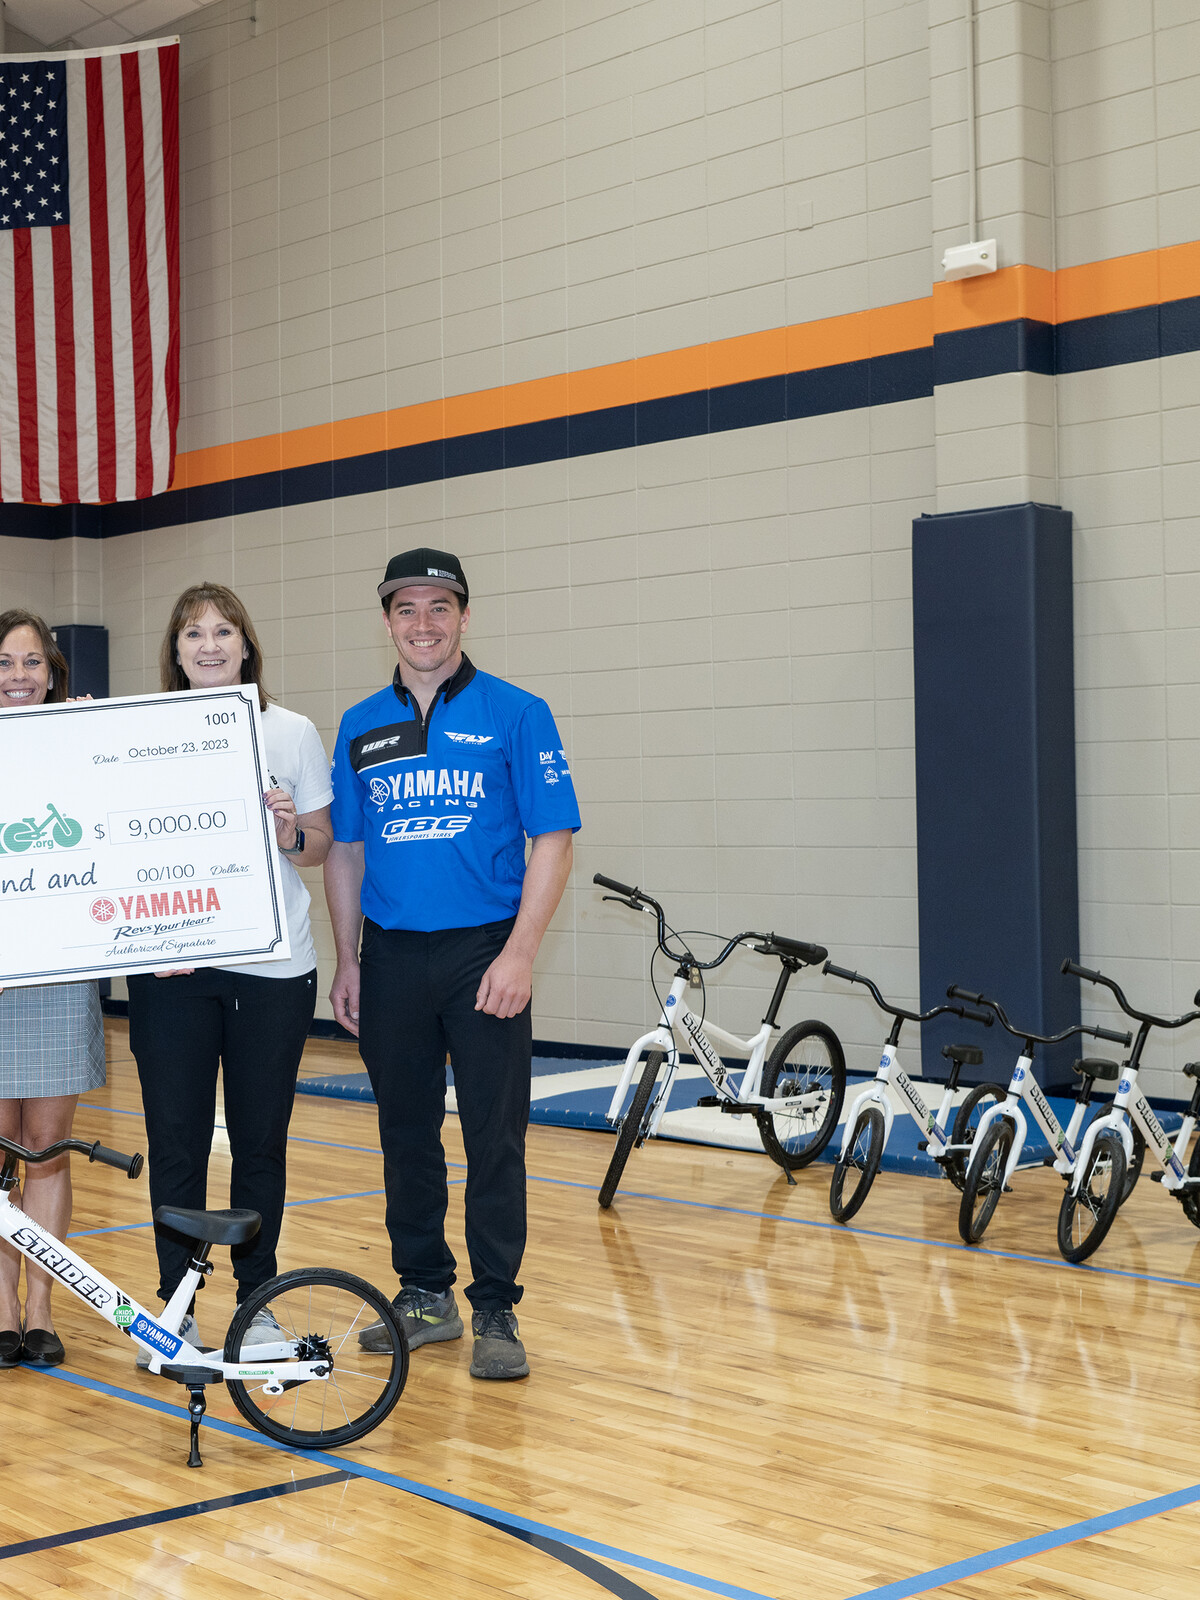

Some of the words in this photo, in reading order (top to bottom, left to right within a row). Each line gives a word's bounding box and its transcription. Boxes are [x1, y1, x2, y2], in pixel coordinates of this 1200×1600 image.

[204, 711, 237, 726] 1001
[448, 731, 494, 743] FLY
[92, 754, 120, 765] Date
[128, 745, 179, 759] October
[181, 741, 199, 753] 23,
[201, 738, 229, 751] 2023
[387, 768, 486, 801] YAMAHA
[376, 798, 479, 814] RACING
[93, 823, 106, 841] $
[128, 811, 227, 840] 9,000.00
[381, 815, 473, 837] GBC
[432, 831, 452, 839] TIRES
[32, 839, 54, 850] .org
[47, 862, 98, 890] and
[136, 864, 195, 883] 00/100
[209, 863, 251, 876] Dollars
[118, 887, 221, 921] YAMAHA
[113, 924, 153, 941] Revs
[153, 920, 181, 936] Your
[181, 915, 213, 928] Heart
[104, 940, 168, 958] Authorized
[165, 938, 217, 954] Signature
[682, 1012, 718, 1068] STRIDER
[896, 1071, 929, 1119] STRIDER
[1029, 1084, 1058, 1135] STRIDER
[1135, 1097, 1167, 1149] STRIDER
[10, 1227, 113, 1309] STRIDER
[146, 1324, 178, 1352] YAMAHA
